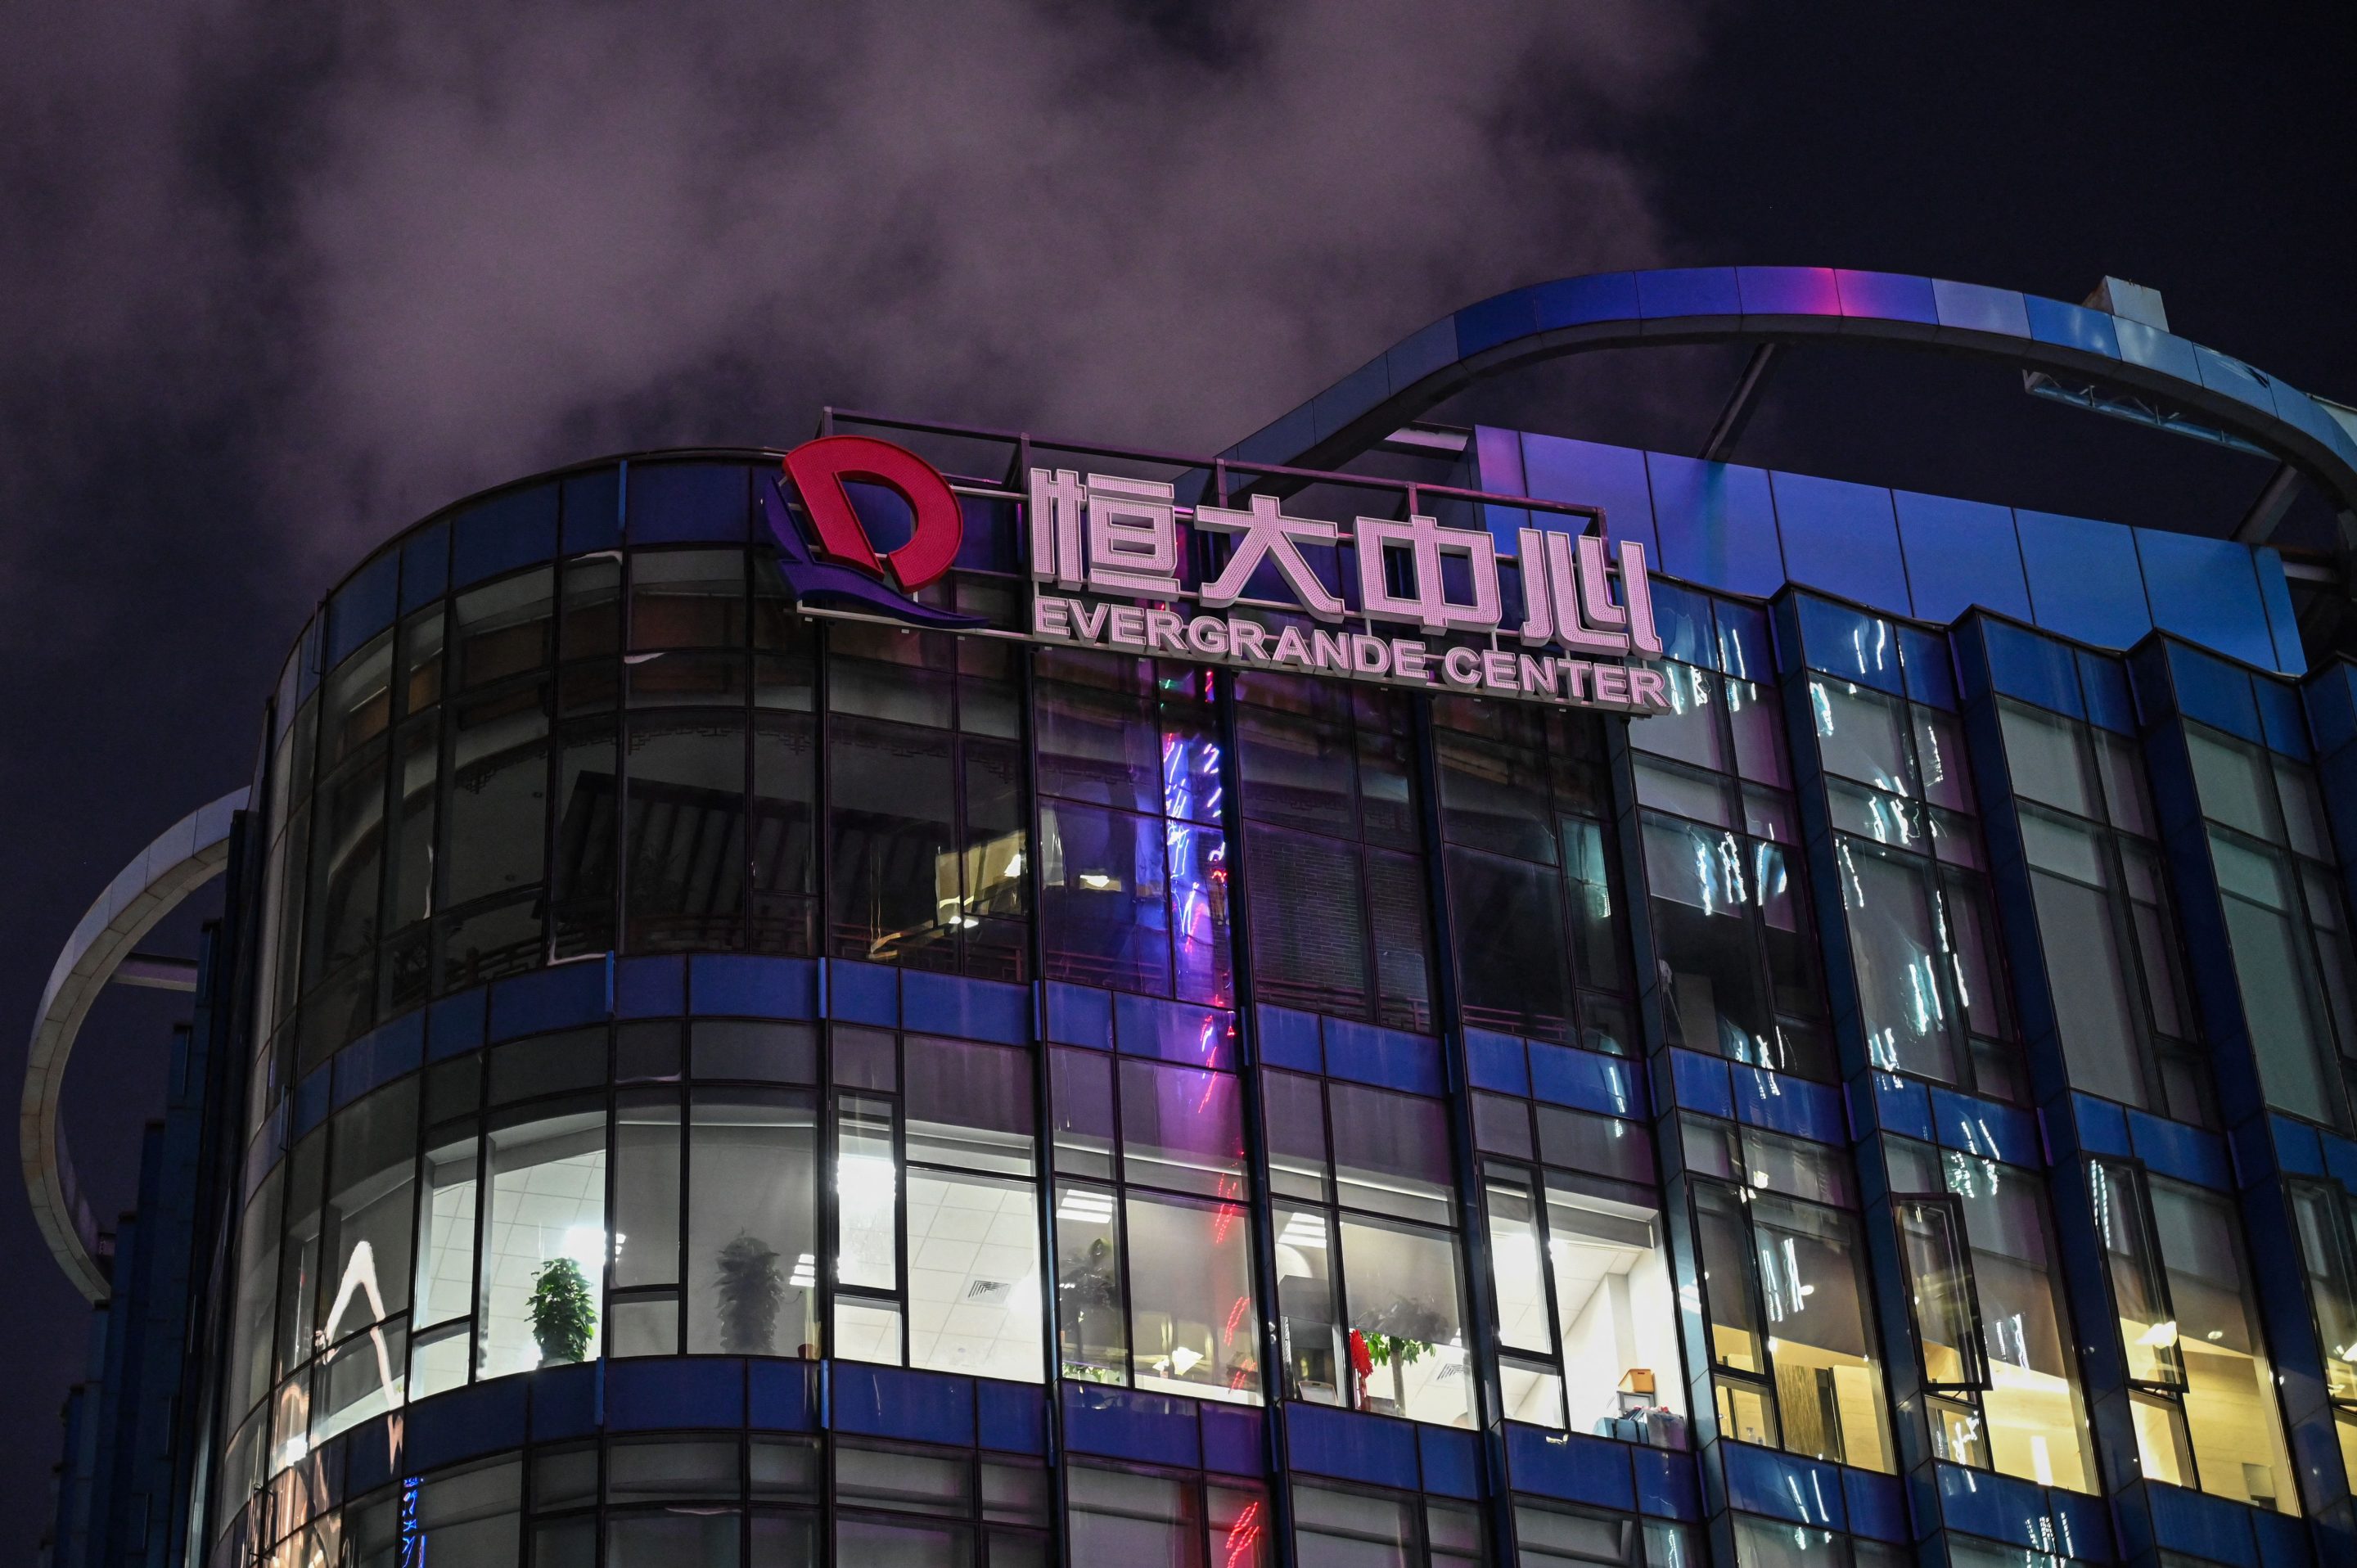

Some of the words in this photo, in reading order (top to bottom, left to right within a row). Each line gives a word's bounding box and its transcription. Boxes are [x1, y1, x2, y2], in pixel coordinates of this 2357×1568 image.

[1028, 467, 1663, 661] 恒大中心
[1033, 595, 1430, 685] EVERGRANDE
[1441, 647, 1672, 715] CENTER
